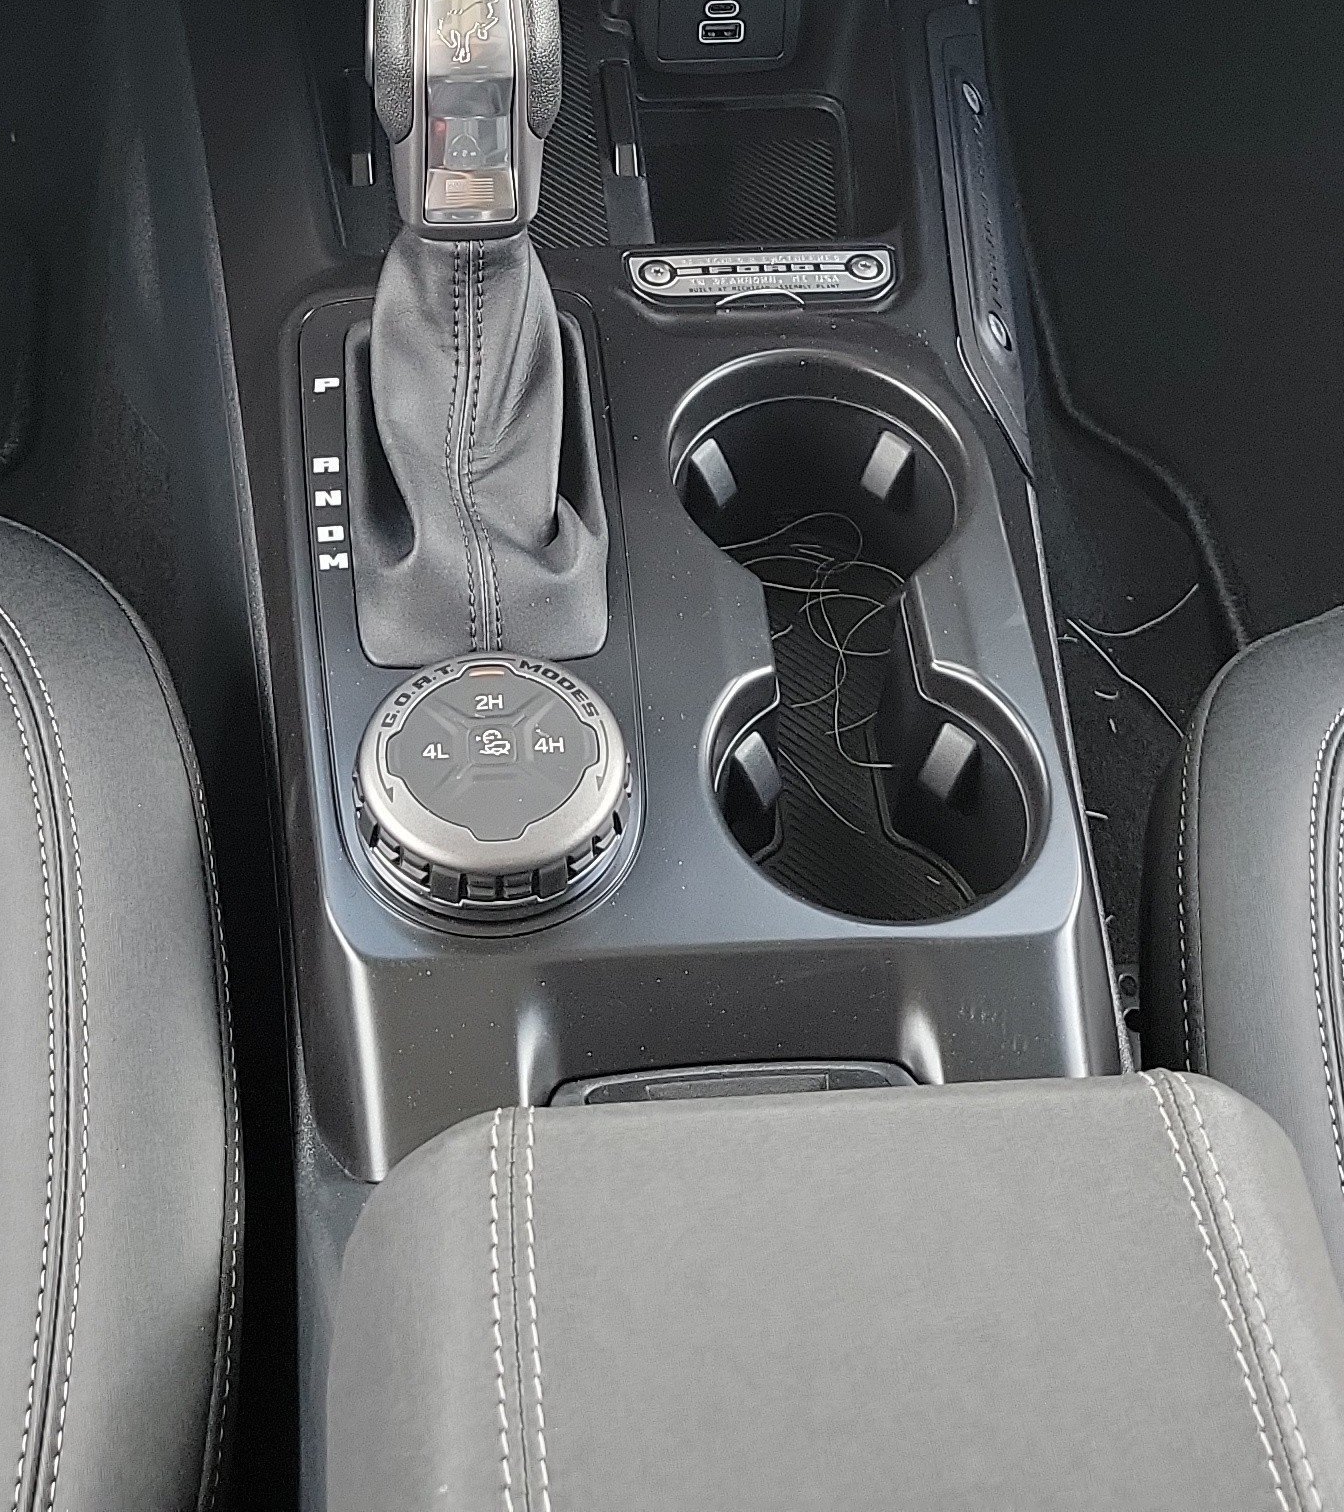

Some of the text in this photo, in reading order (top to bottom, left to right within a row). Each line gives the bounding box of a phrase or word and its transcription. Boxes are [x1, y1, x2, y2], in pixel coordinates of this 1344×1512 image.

[313, 377, 340, 393] P
[313, 456, 340, 473] R
[314, 489, 342, 507] N
[316, 525, 345, 543] D
[318, 552, 349, 570] M
[518, 658, 601, 718] MODES
[474, 693, 504, 710] 2H
[422, 743, 450, 760] 4L
[533, 736, 565, 754] 4H
